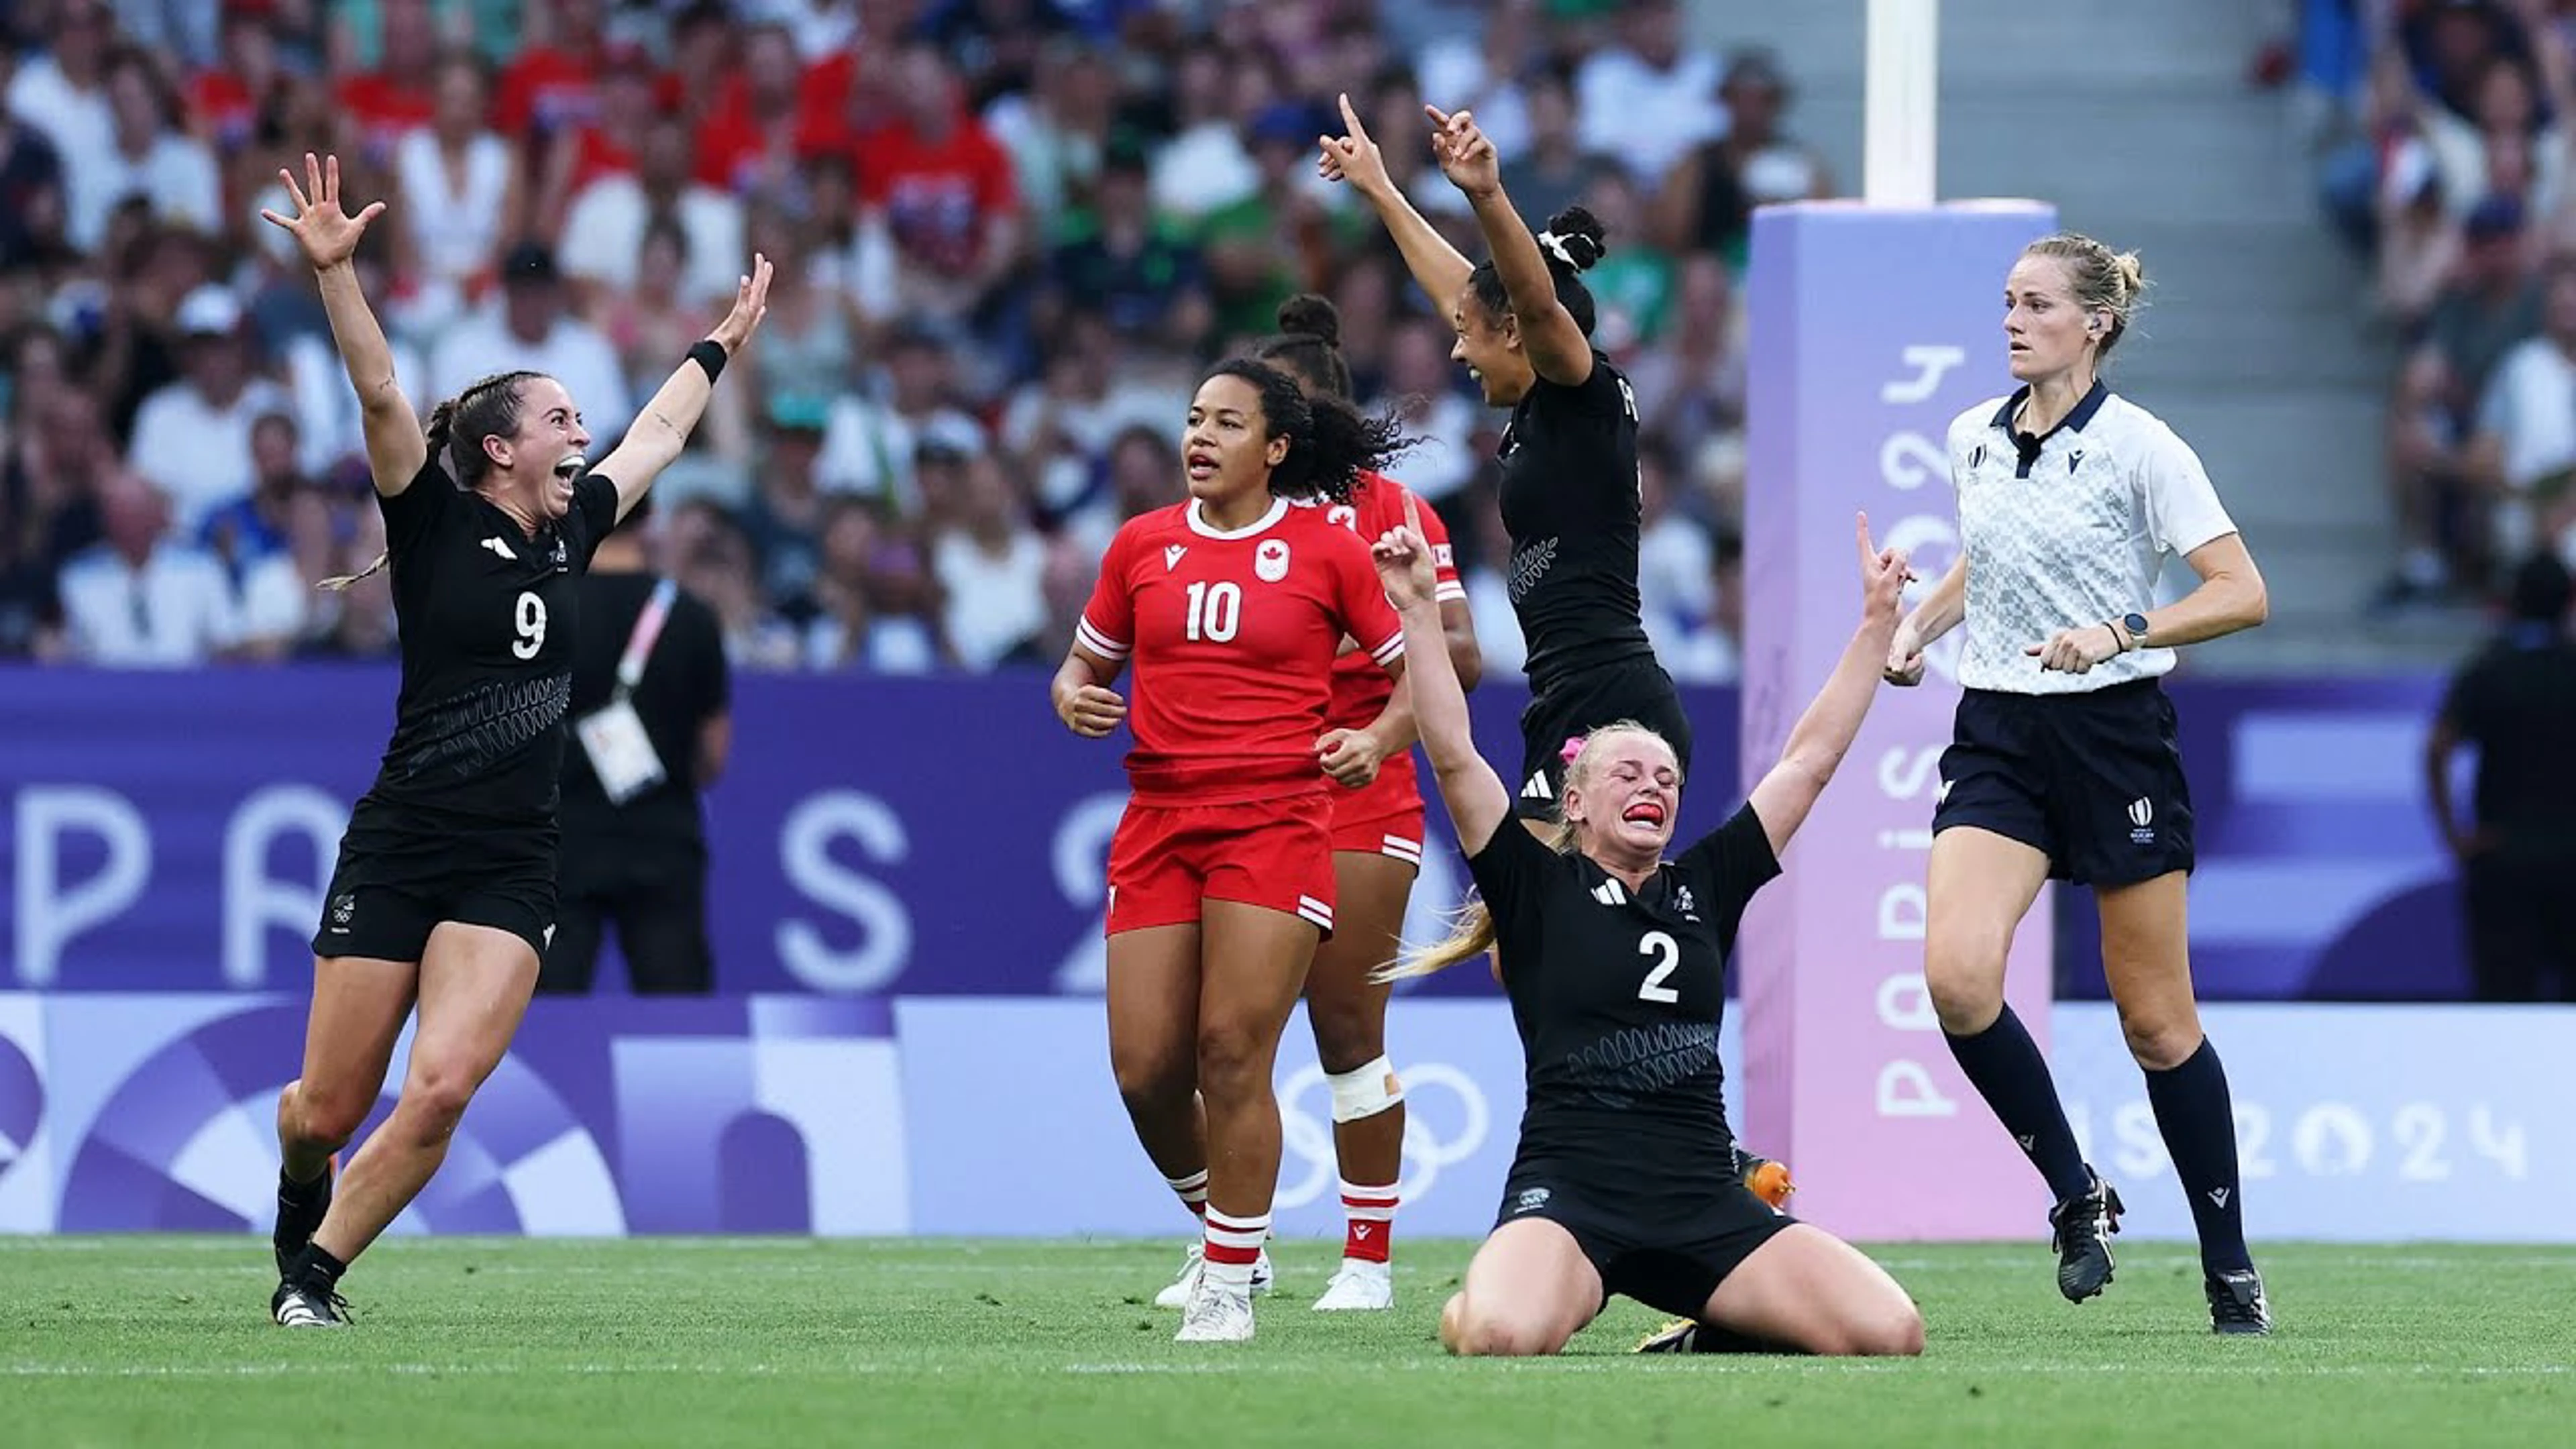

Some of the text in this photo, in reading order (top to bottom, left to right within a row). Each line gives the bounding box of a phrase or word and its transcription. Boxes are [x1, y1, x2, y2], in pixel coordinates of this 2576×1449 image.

[512, 590, 547, 660] 9
[1187, 580, 1241, 643] 10
[1638, 930, 1679, 1004] 2
